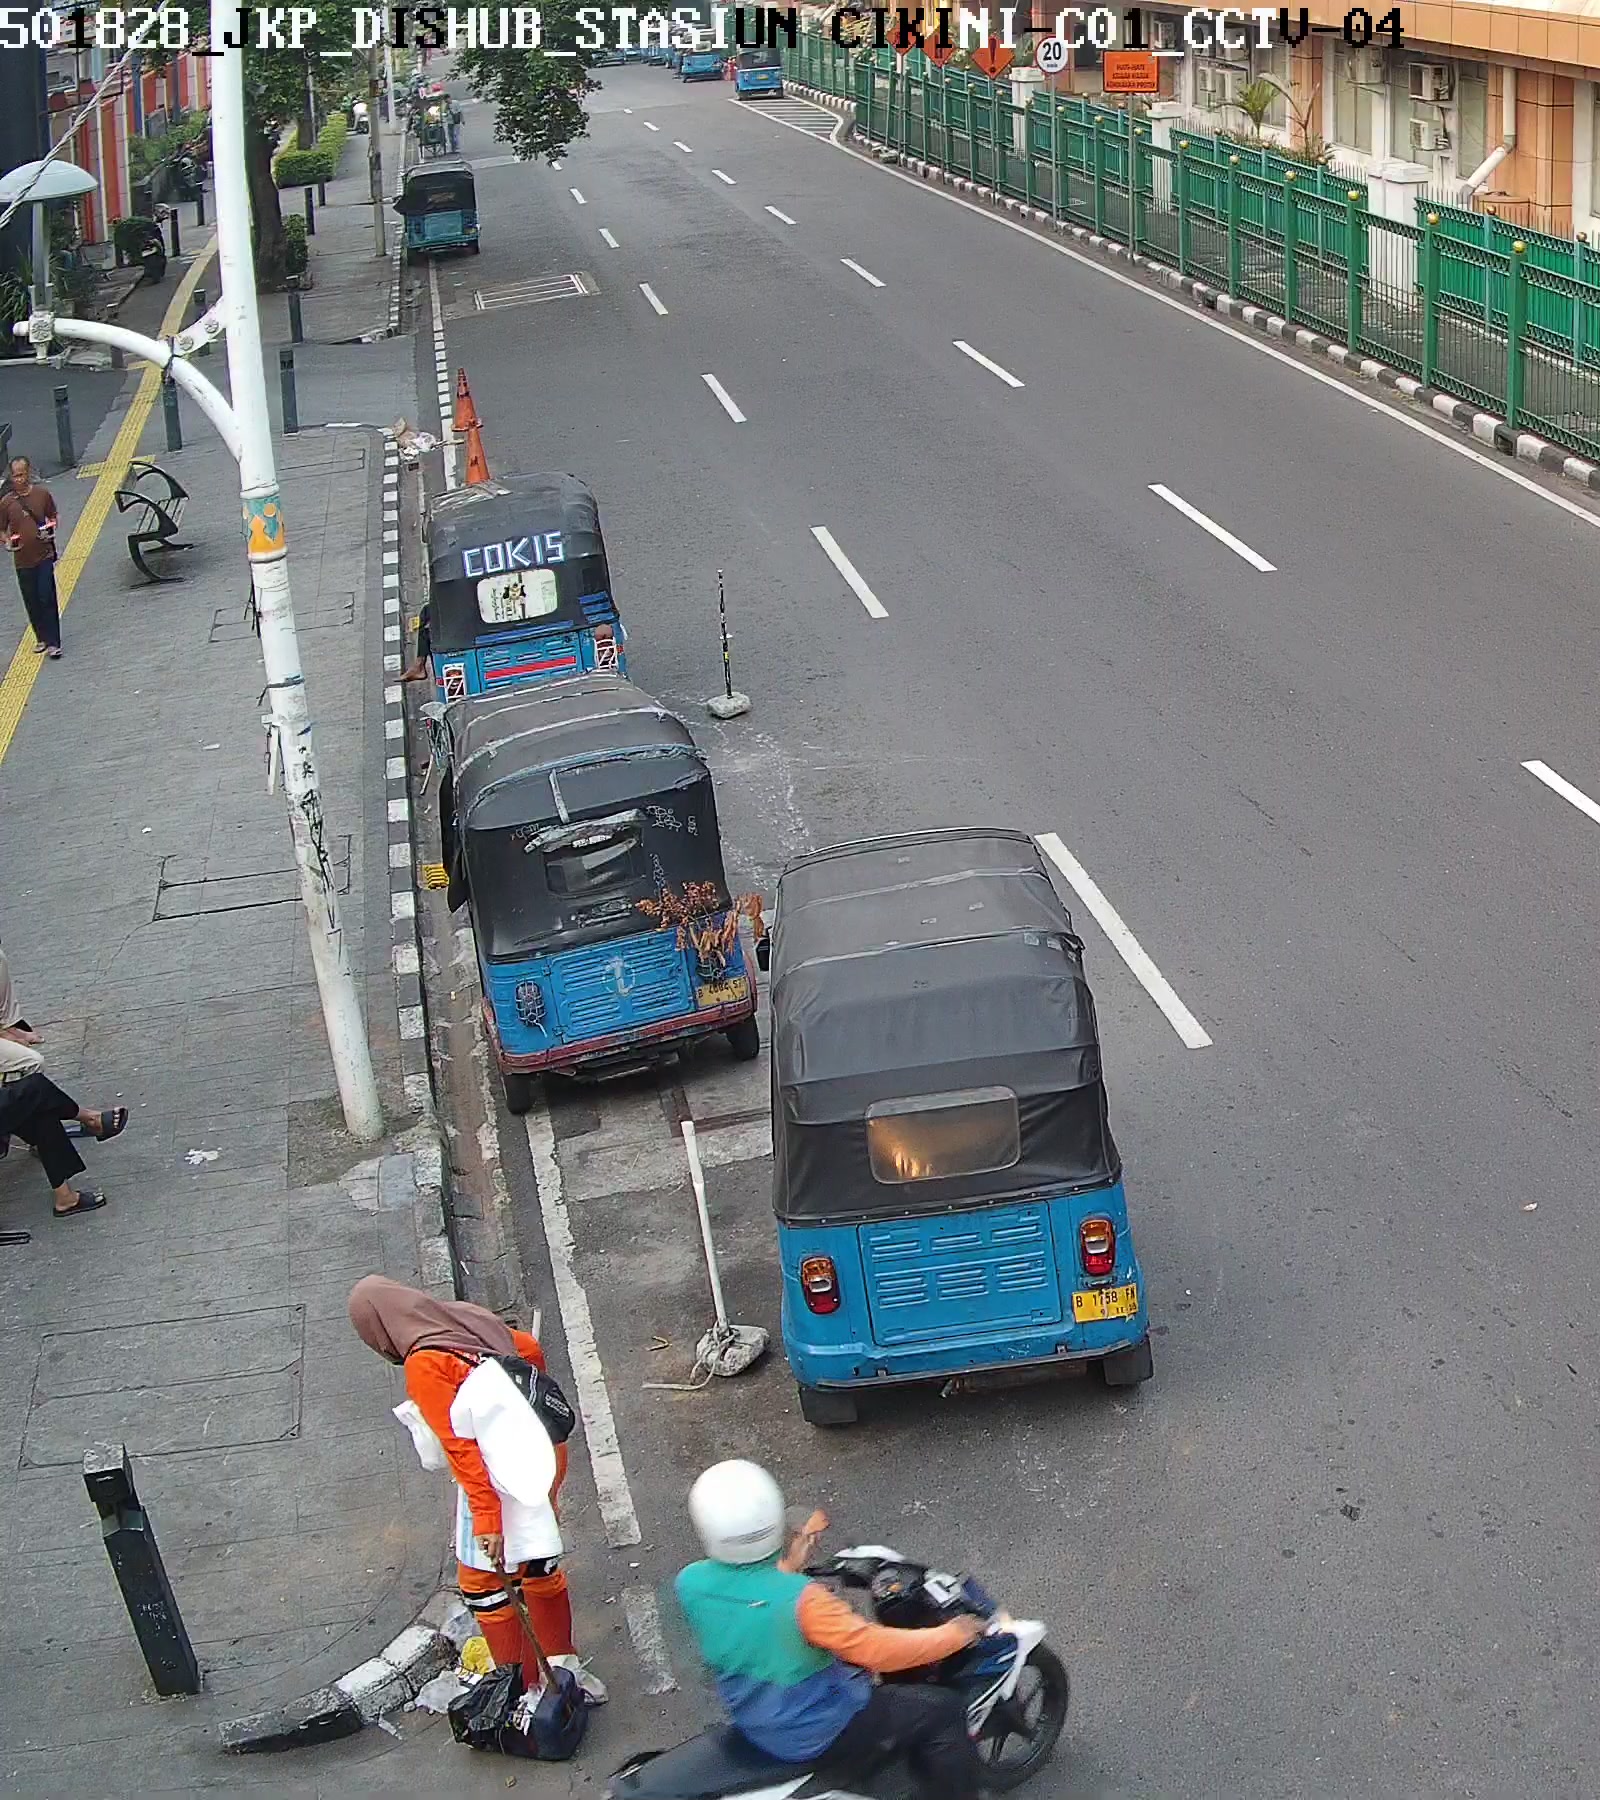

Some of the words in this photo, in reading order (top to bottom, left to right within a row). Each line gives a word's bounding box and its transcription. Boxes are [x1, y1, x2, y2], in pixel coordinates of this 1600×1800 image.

[1042, 41, 1062, 61] 20
[462, 531, 564, 578] COKIS
[1076, 1296, 1083, 1308] B
